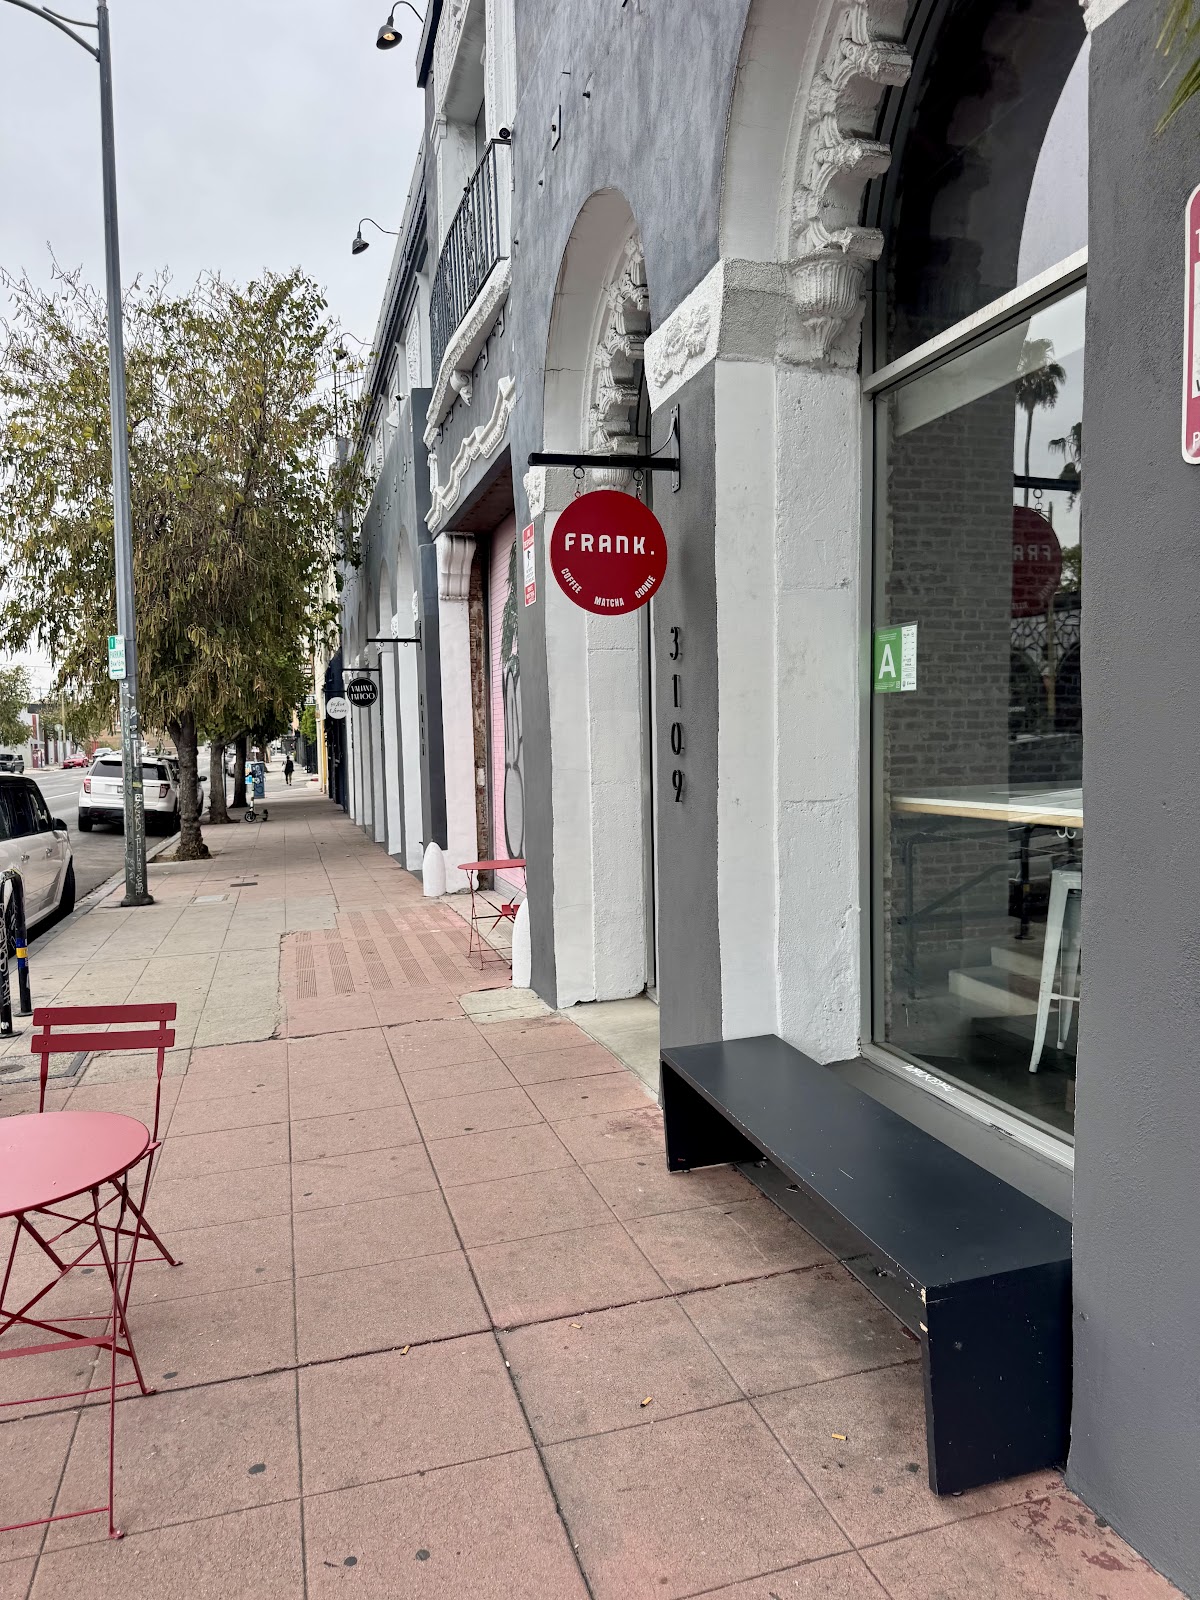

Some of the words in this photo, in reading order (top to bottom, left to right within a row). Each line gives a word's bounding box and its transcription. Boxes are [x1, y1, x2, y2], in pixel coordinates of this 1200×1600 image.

[564, 533, 655, 555] FRANK.
[561, 568, 582, 594] COFFEE
[594, 596, 625, 607] MATCHA
[635, 575, 656, 599] COOKIE
[878, 643, 896, 679] A
[670, 627, 683, 802] 3109
